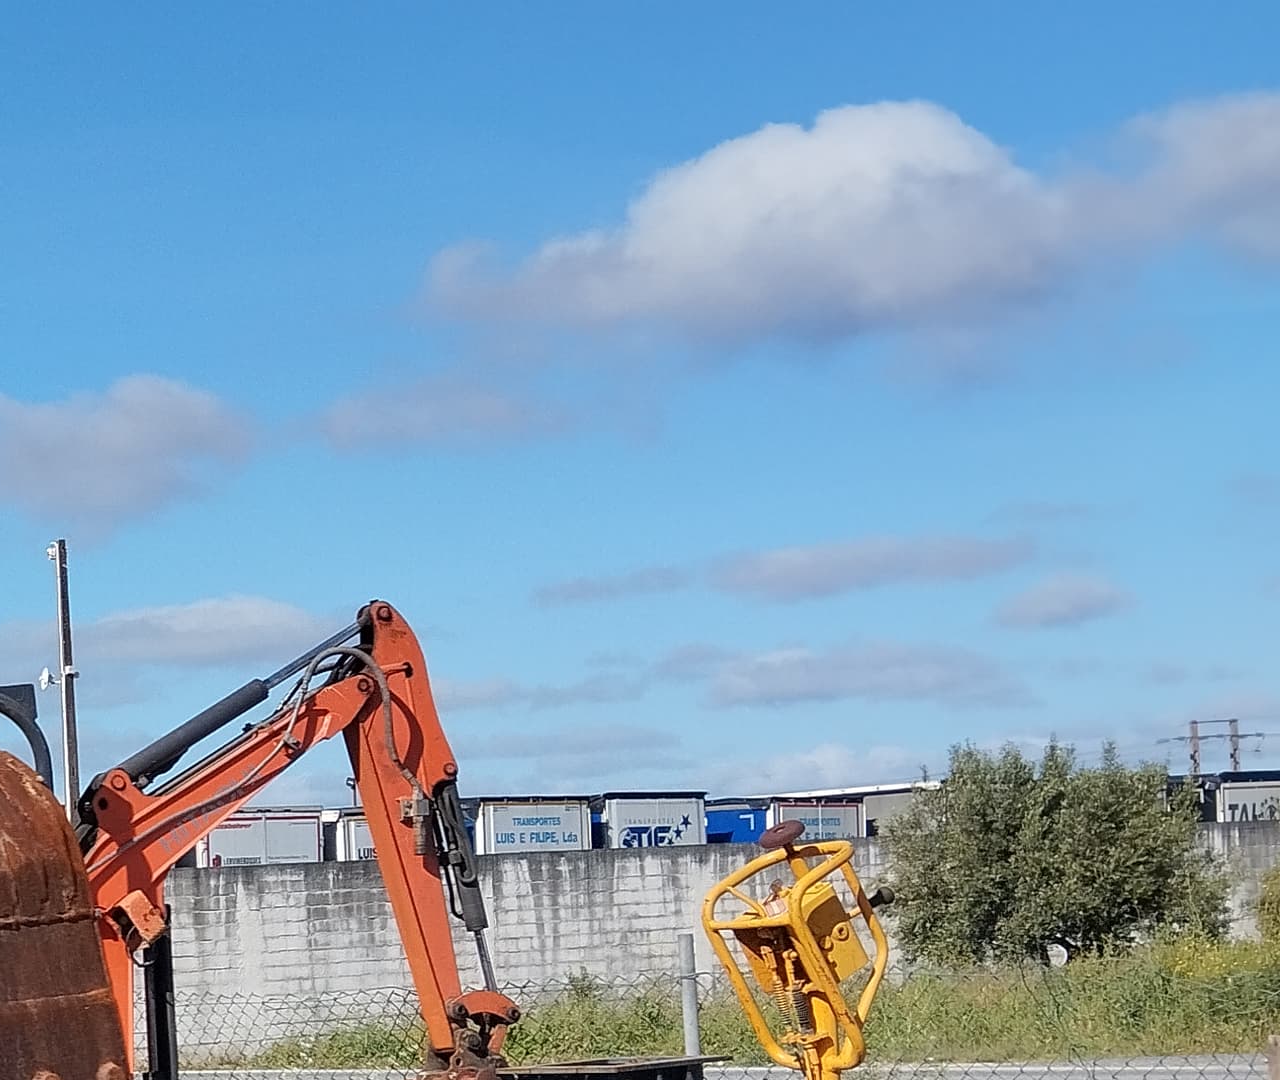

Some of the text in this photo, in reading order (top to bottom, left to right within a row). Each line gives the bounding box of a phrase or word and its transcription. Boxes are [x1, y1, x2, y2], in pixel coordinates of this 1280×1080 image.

[512, 816, 560, 826] TRANSPORTES
[496, 831, 578, 845] LUIS E FILIPE, Lda
[358, 848, 378, 859] LUIS
